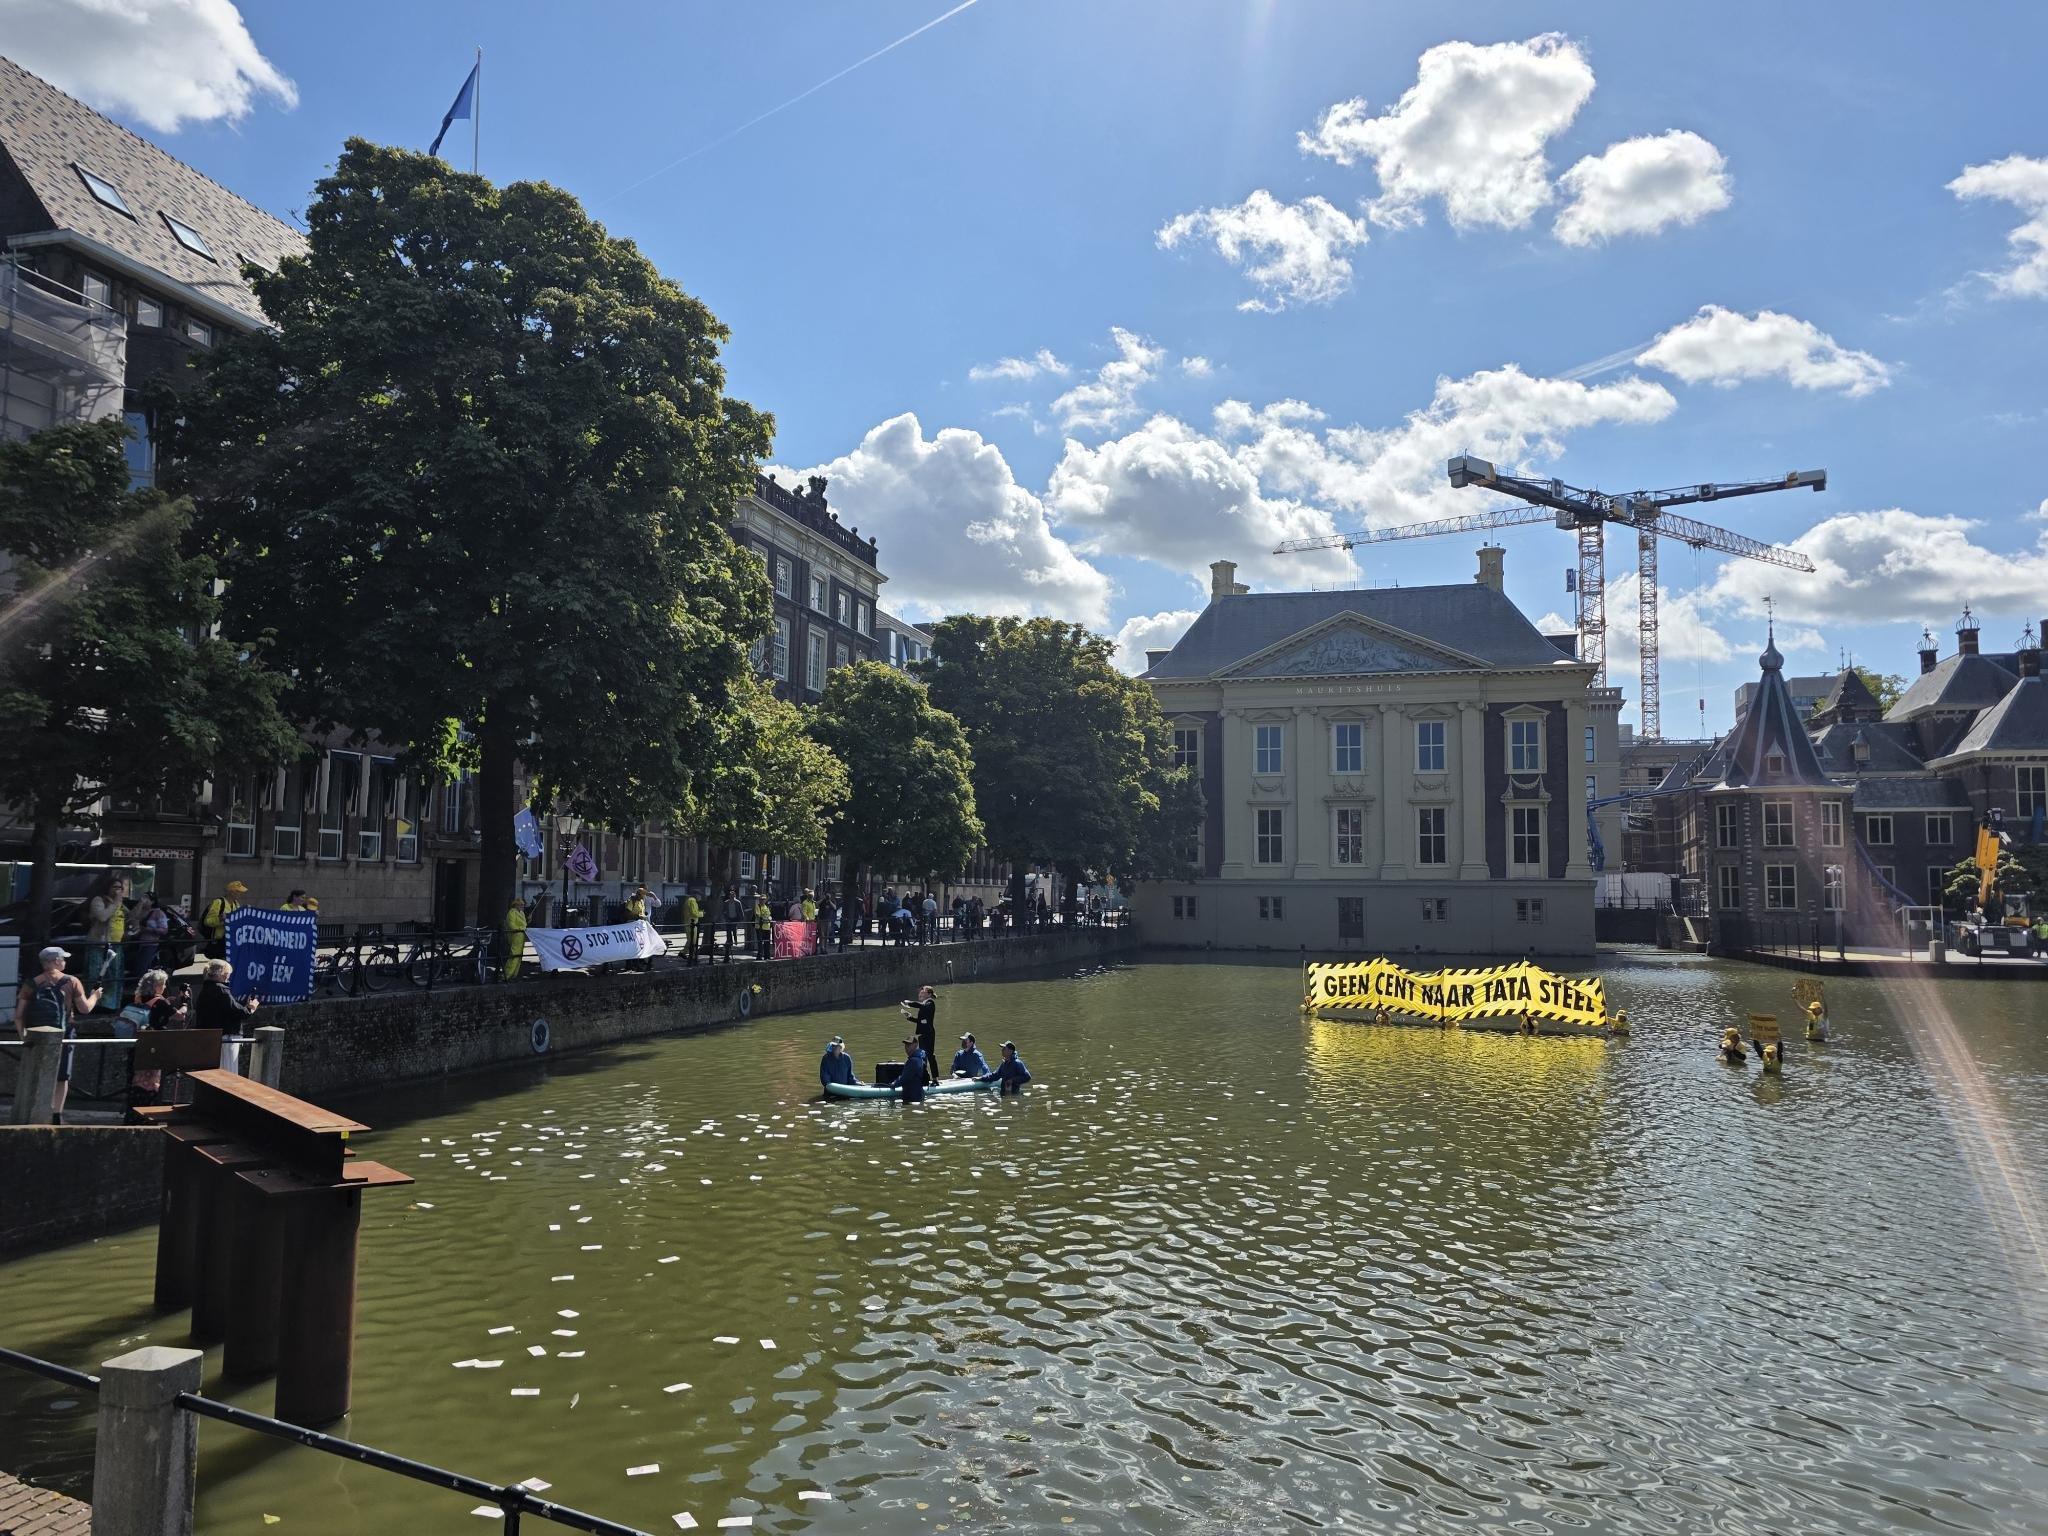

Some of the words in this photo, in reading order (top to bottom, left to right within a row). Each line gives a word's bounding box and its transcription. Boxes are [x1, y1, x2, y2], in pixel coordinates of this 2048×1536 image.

[1296, 684, 1401, 695] MAURITSHUIS
[235, 925, 307, 950] GEZONDHEID
[586, 932, 610, 948] STOP
[247, 961, 266, 981] OP
[1324, 972, 1370, 997] GEEN
[1375, 972, 1415, 1001] CENT
[1421, 983, 1475, 1008] NAAR
[1482, 975, 1532, 1004] TATA
[1539, 979, 1595, 1013] STEEL
